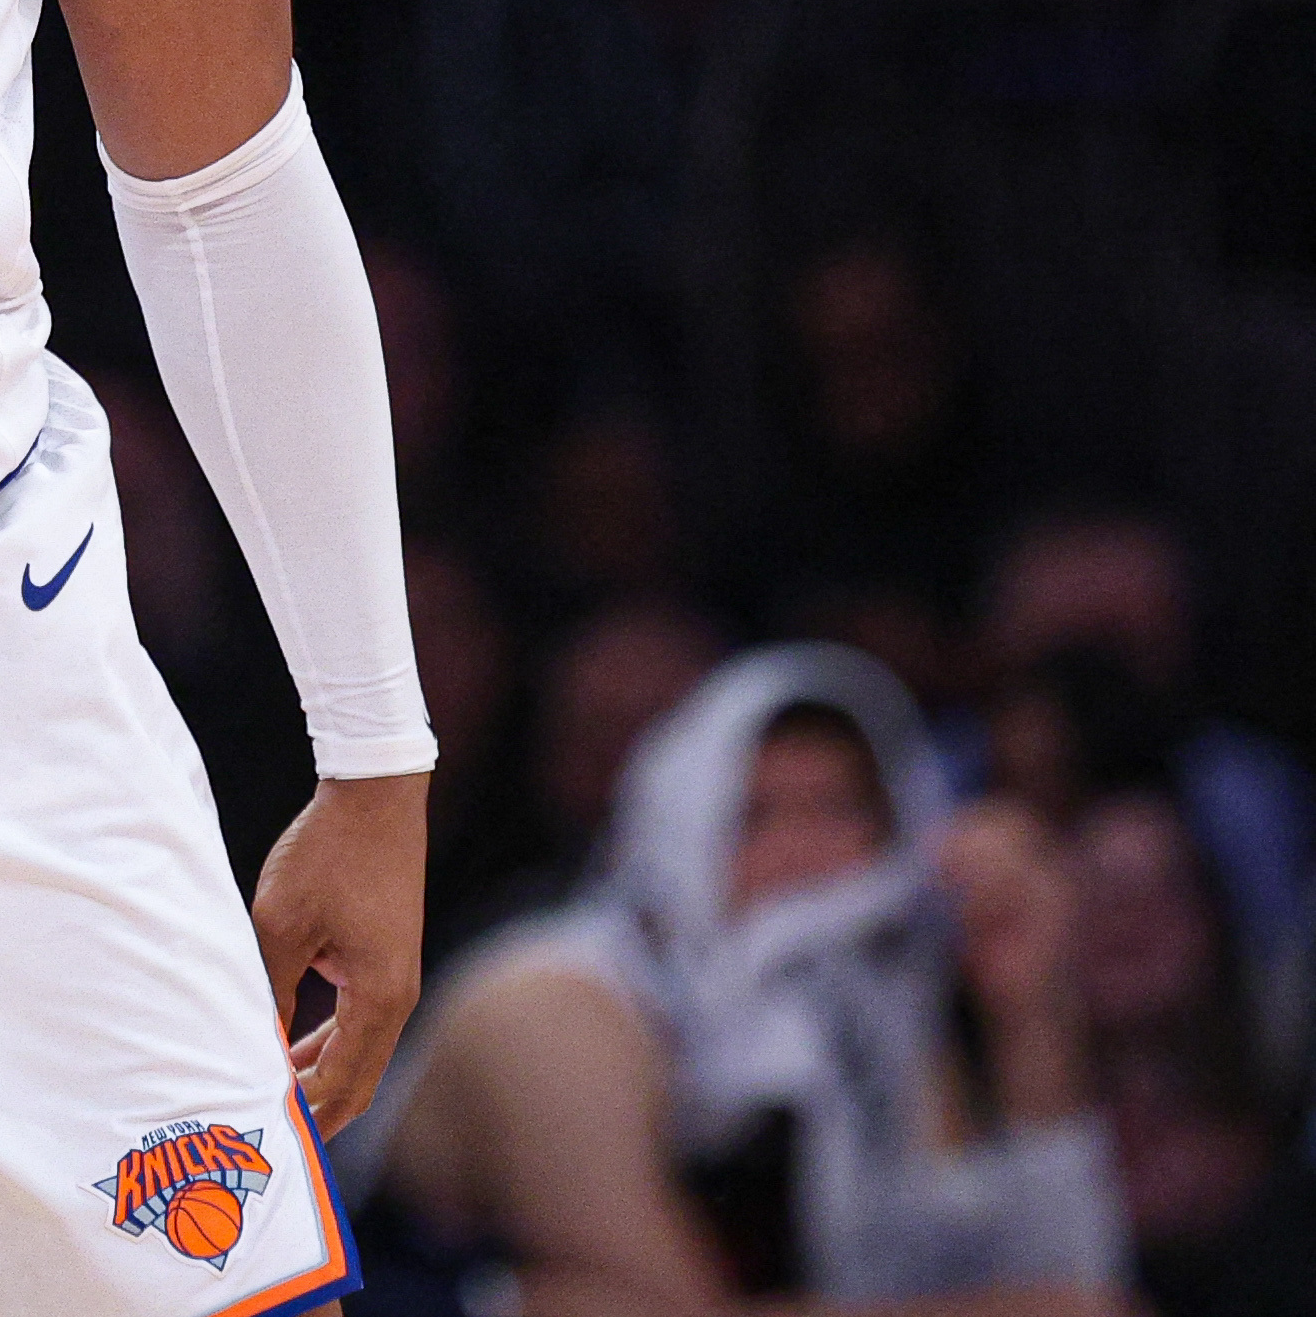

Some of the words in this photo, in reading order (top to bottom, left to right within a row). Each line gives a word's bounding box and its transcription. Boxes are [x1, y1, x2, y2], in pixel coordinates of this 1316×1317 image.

[142, 1126, 168, 1150] NEW
[169, 1119, 205, 1138] YORK
[114, 1123, 273, 1227] KNICKS
